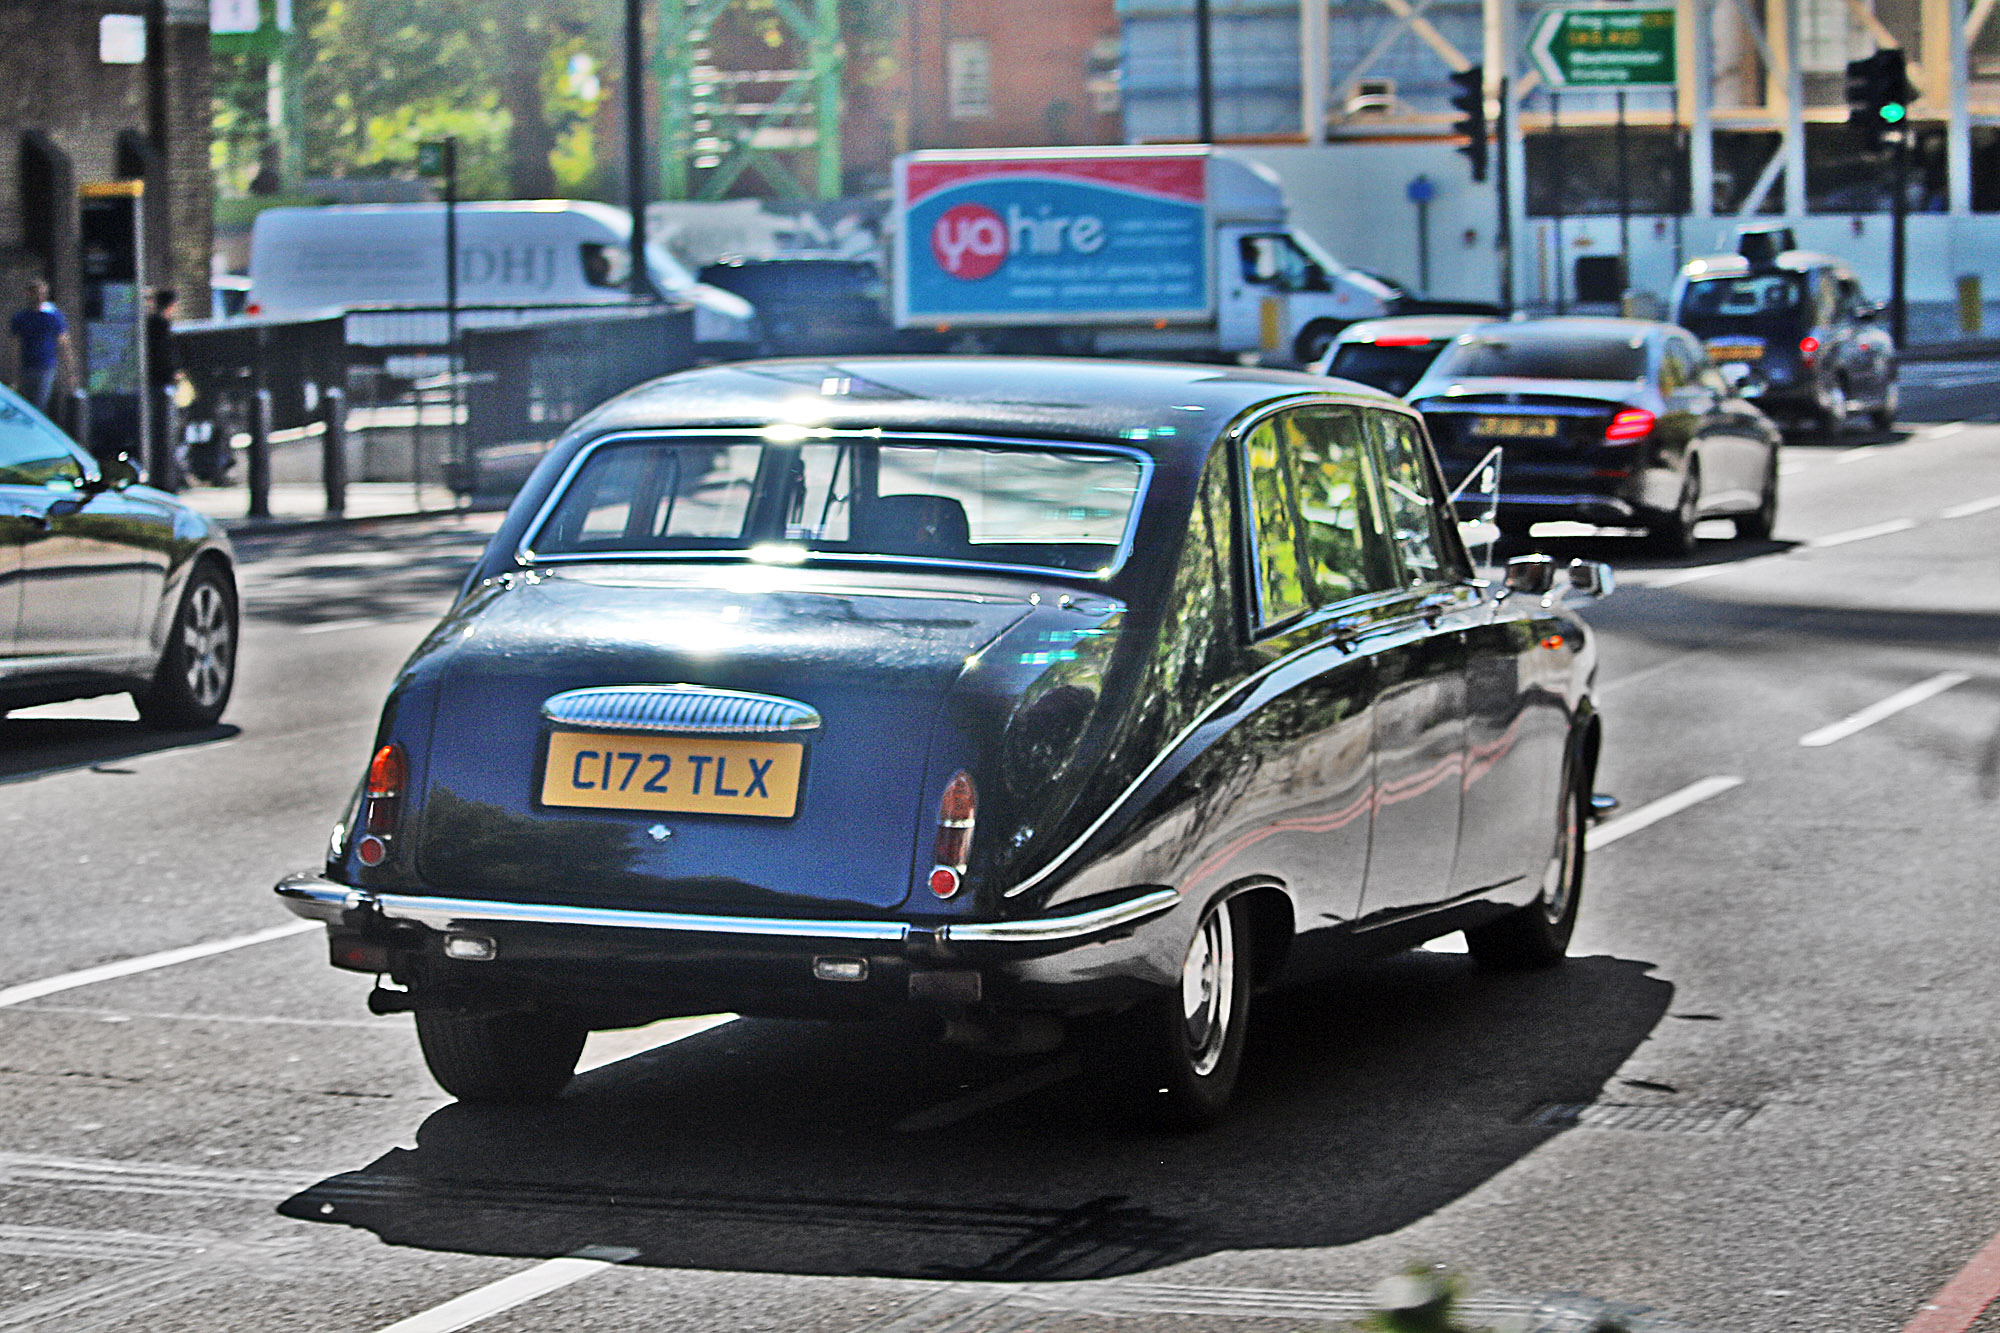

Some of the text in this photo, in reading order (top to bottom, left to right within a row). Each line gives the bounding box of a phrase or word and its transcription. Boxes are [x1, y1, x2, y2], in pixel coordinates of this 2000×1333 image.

[461, 246, 556, 292] DHJ
[571, 750, 774, 799] C172 TLX
